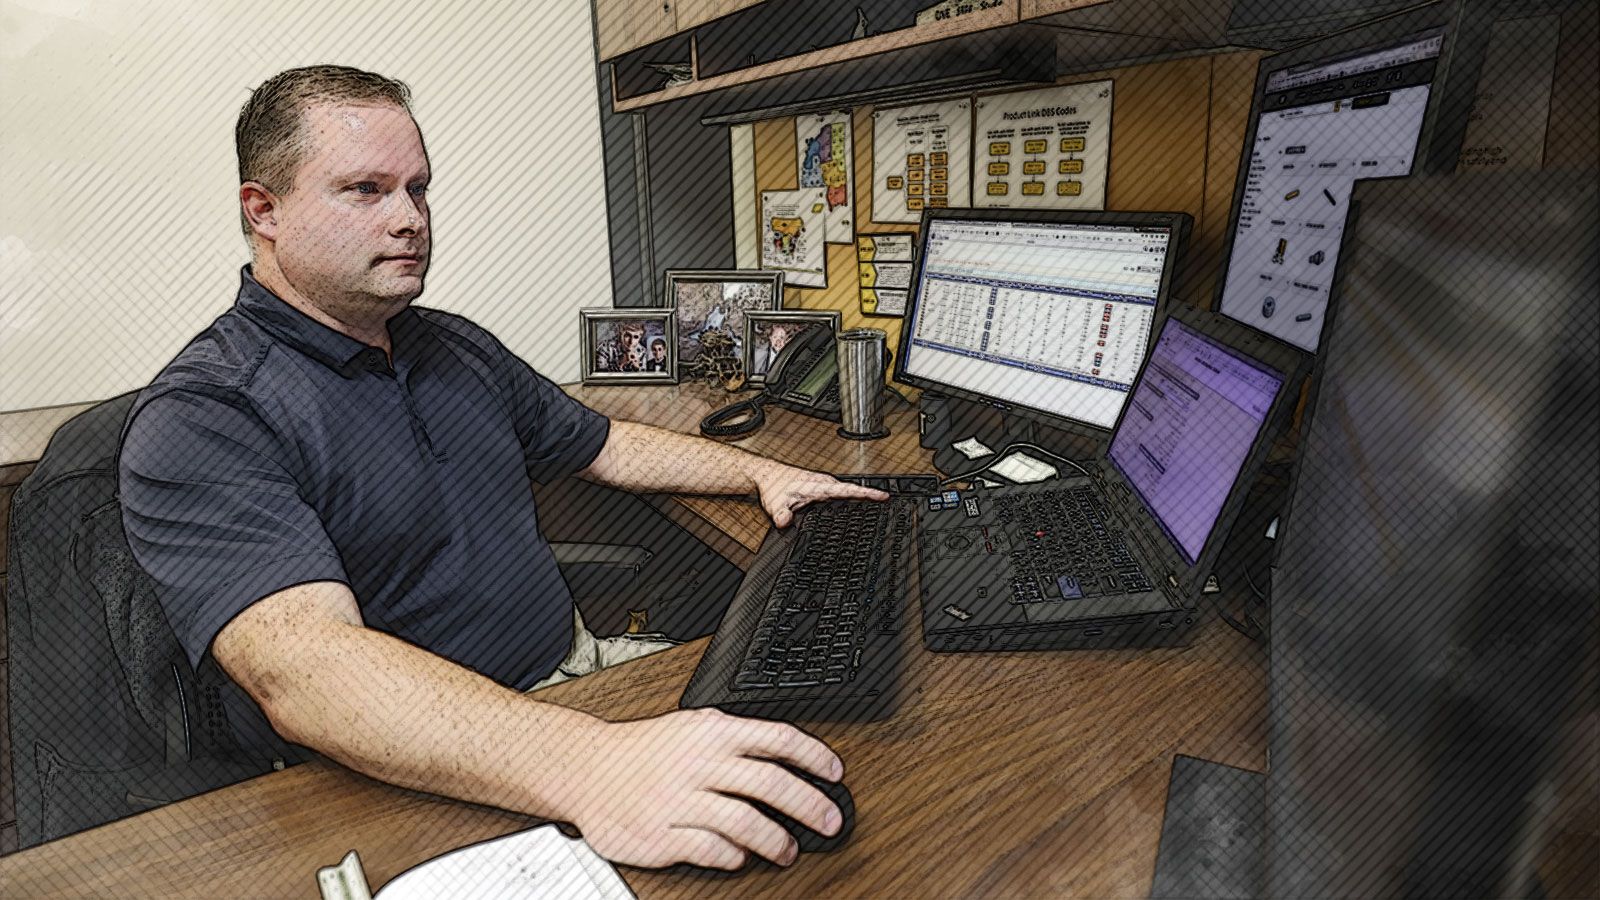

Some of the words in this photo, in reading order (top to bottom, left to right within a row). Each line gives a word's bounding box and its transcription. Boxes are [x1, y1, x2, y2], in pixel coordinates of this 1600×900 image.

[1003, 111, 1027, 121] Product
[1027, 109, 1041, 119] Link
[1056, 106, 1077, 116] Codes
